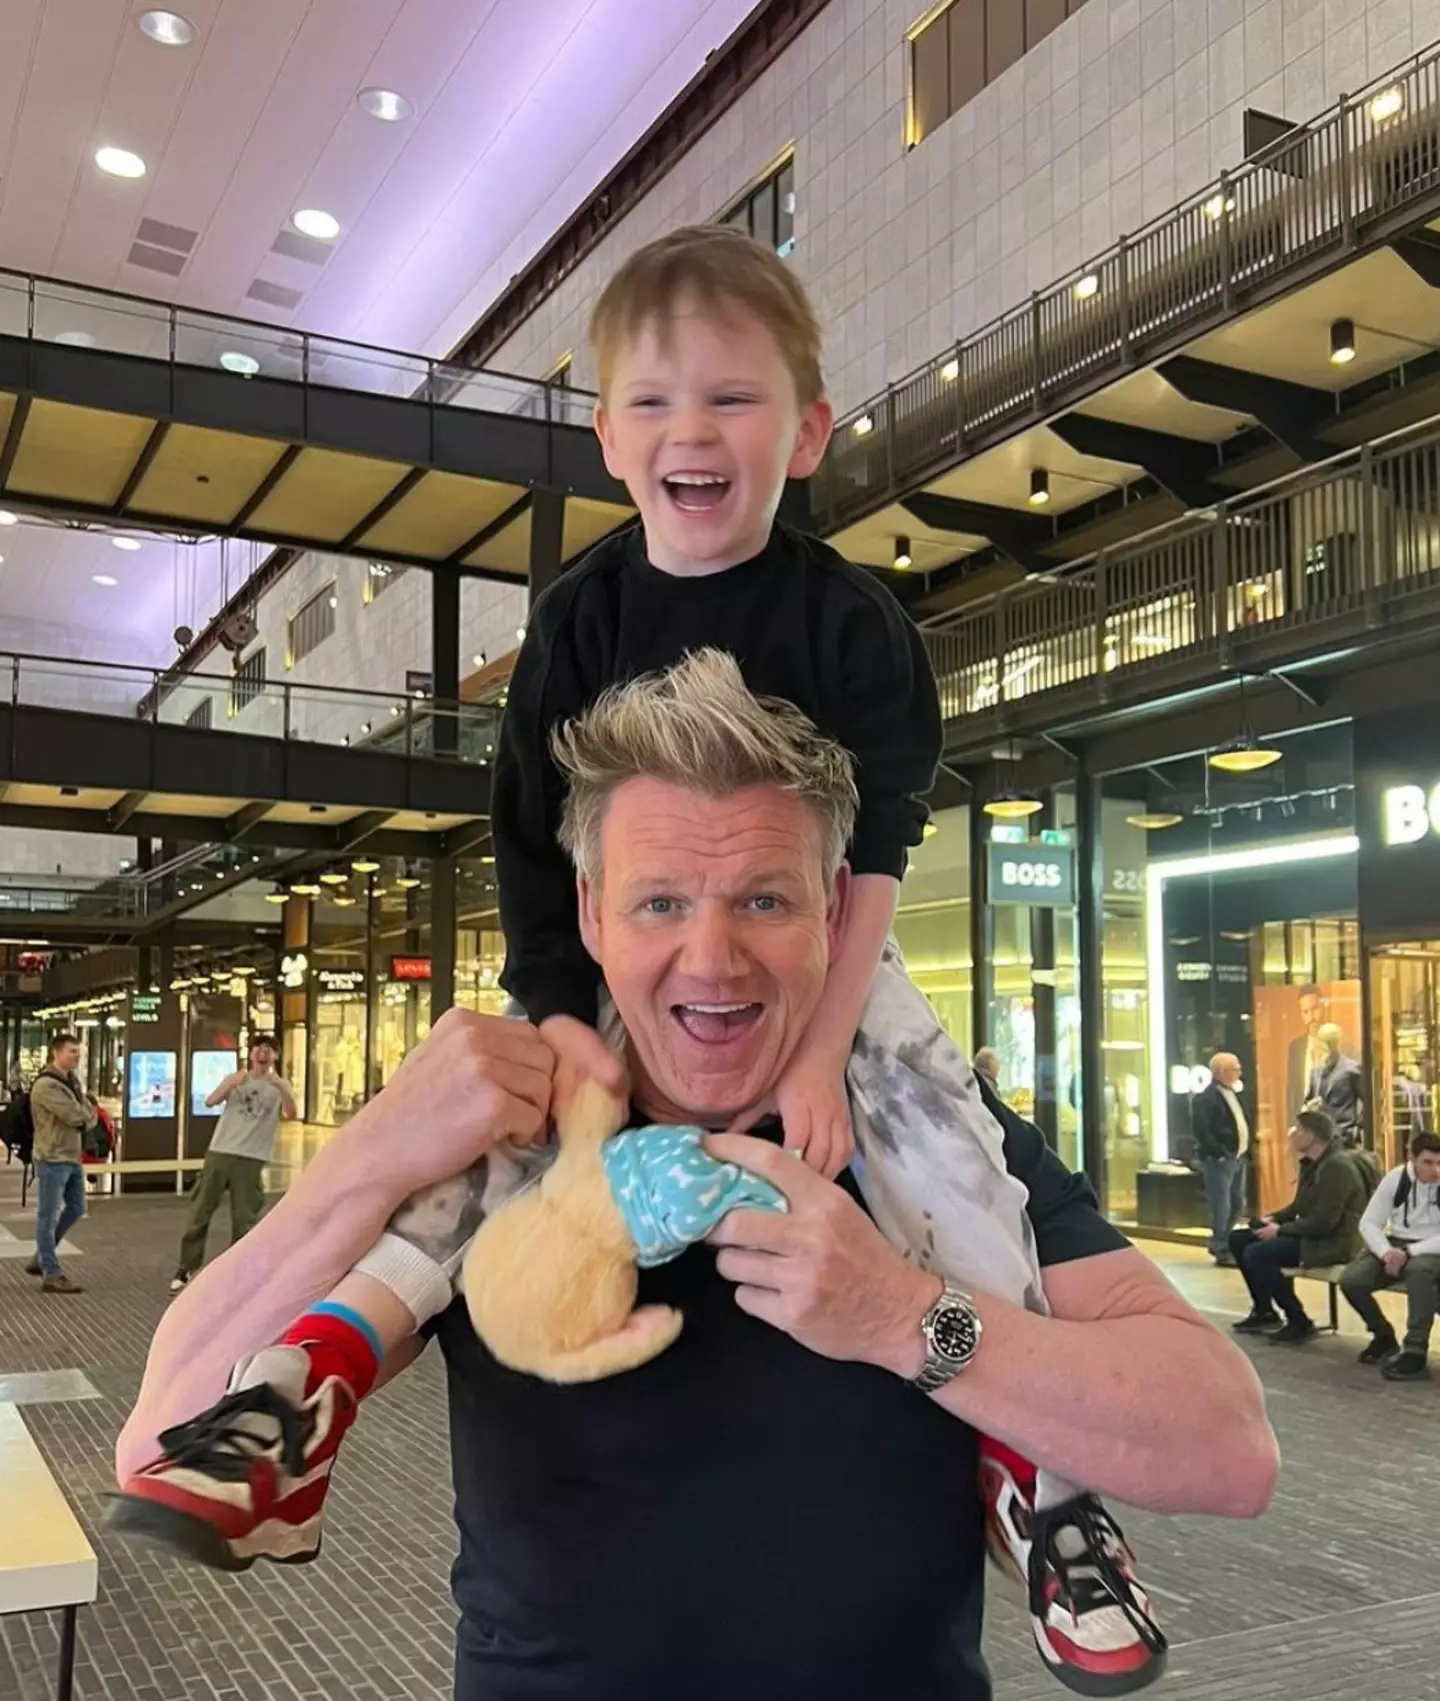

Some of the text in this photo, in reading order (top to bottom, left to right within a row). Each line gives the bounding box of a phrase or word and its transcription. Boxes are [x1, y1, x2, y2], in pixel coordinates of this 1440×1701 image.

[1385, 782, 1440, 845] B
[1002, 861, 1062, 887] BOSS
[1170, 1064, 1244, 1094] BO
